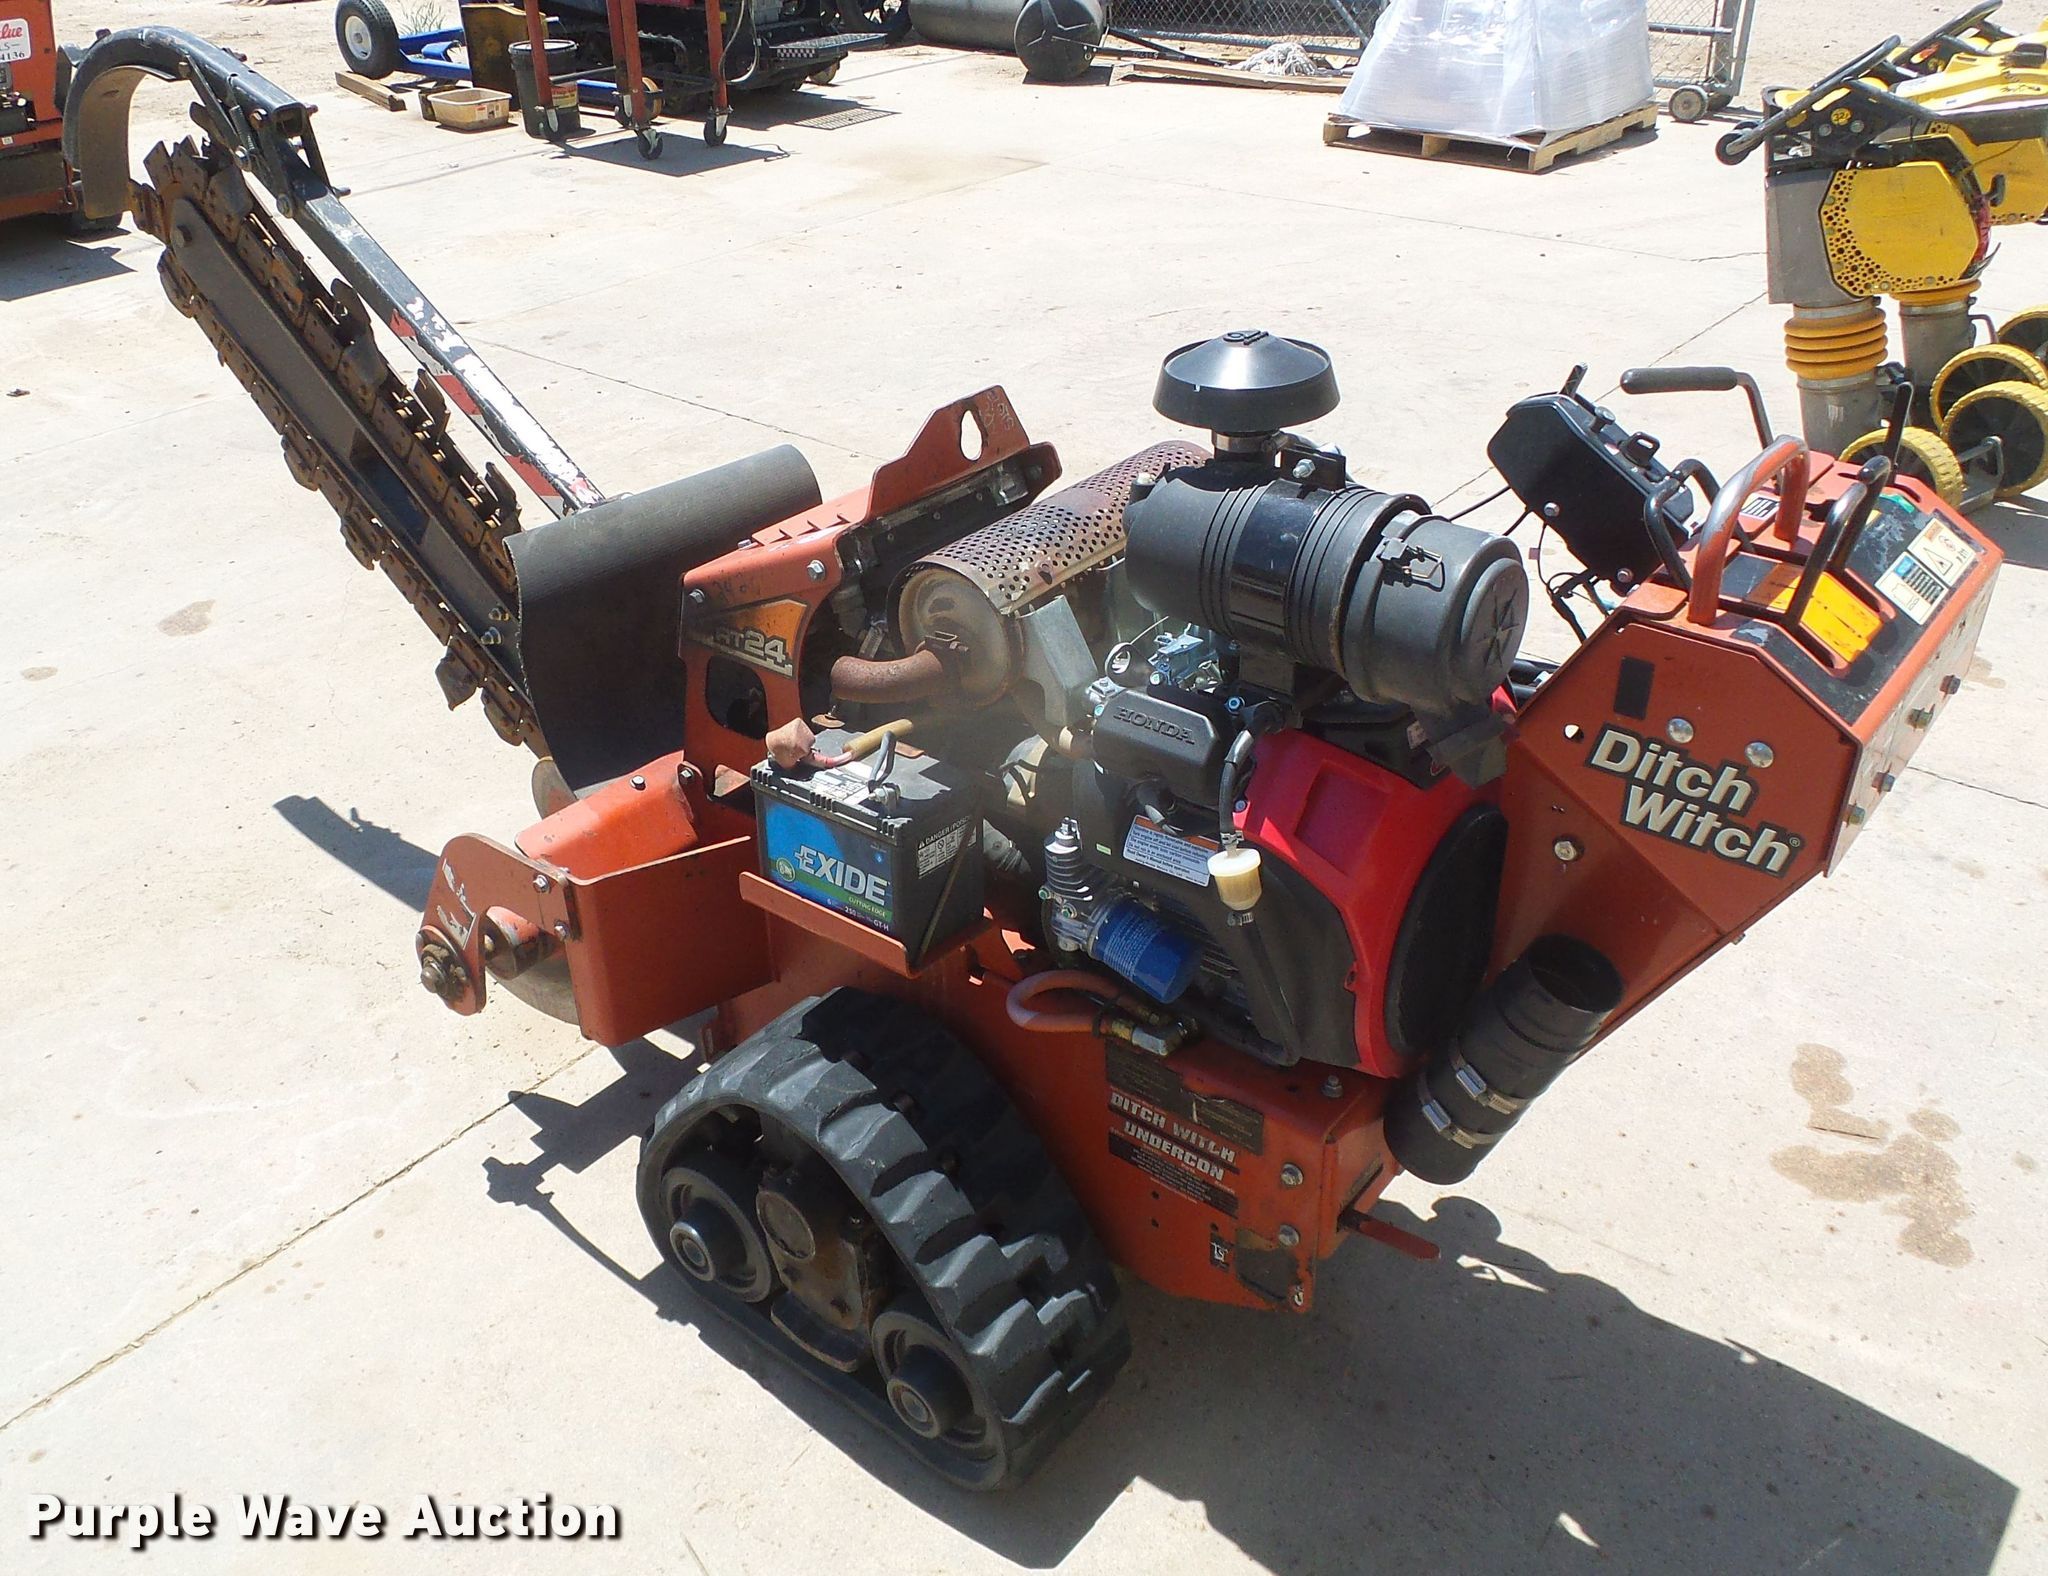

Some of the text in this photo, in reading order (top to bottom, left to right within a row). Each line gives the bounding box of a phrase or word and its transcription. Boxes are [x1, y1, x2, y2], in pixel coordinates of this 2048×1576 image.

[0, 23, 23, 39] lue
[1113, 706, 1195, 745] HONDA
[1591, 729, 1752, 811] Ditch
[794, 845, 888, 906] EXIDE
[1111, 1092, 1166, 1129] DITCH
[1124, 1121, 1224, 1181] UNDERCON
